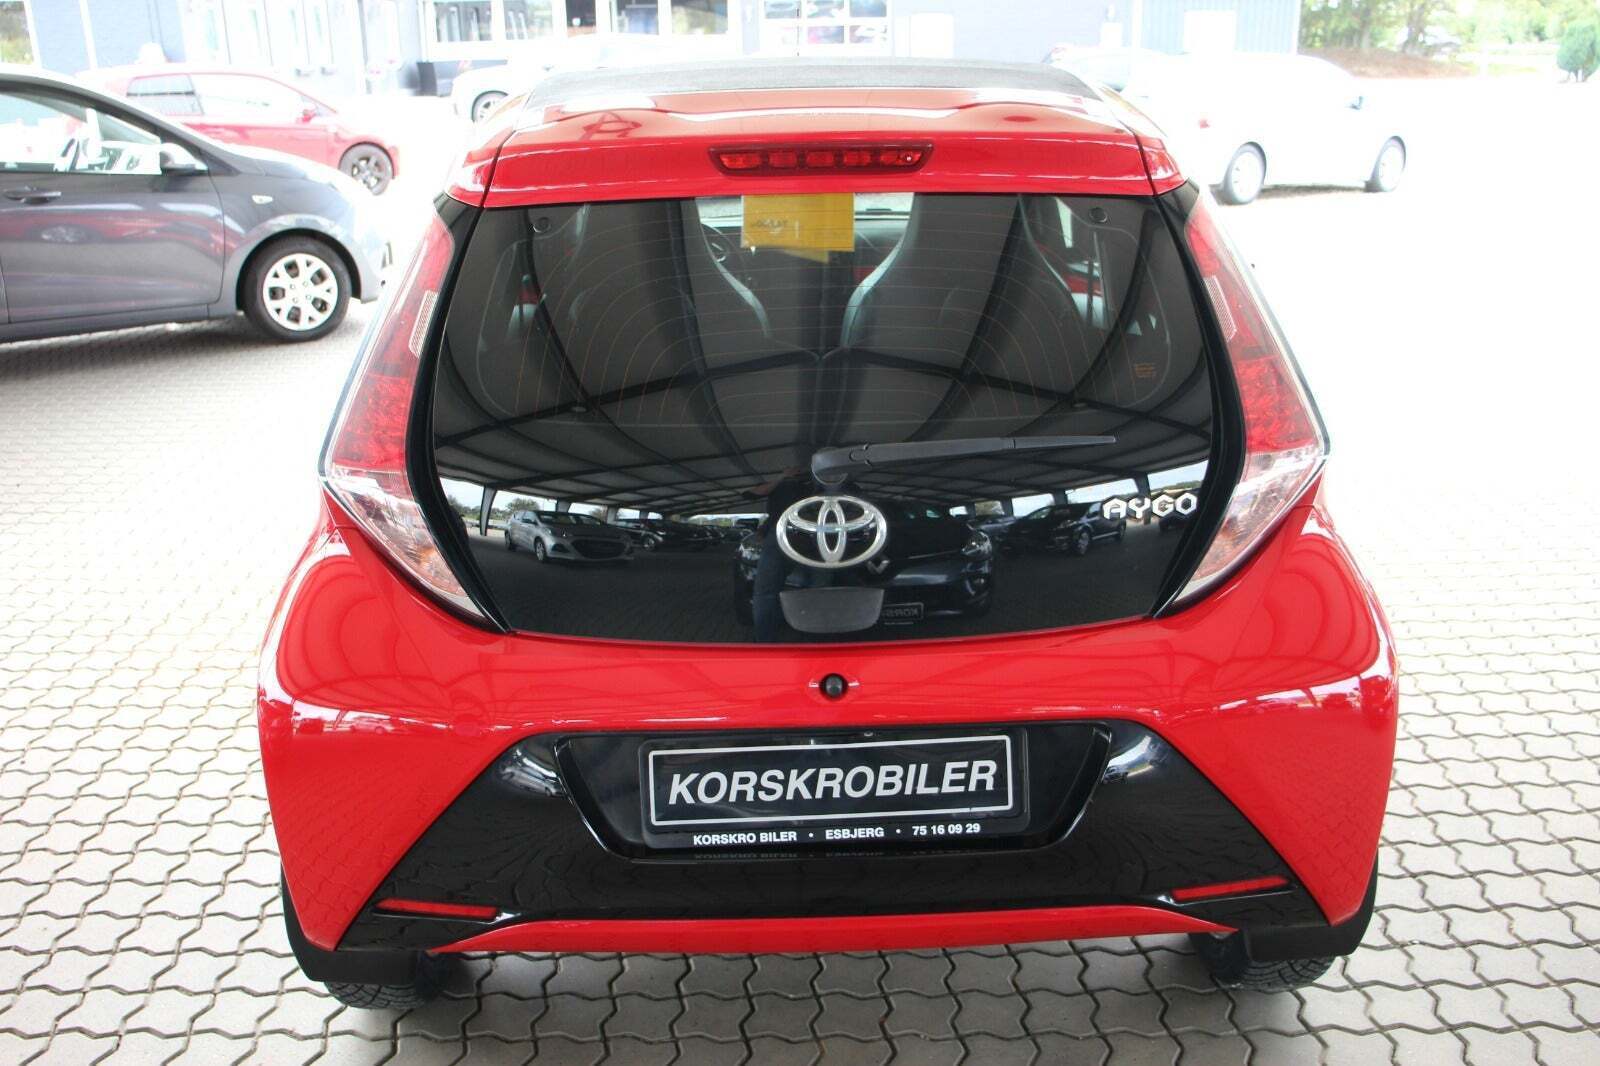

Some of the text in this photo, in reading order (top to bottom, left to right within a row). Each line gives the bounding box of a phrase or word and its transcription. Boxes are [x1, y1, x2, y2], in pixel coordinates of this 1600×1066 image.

[1102, 492, 1198, 519] AYGO
[668, 759, 998, 805] KORSKROBILER
[693, 822, 981, 846] KORSKRO BILER ESBJERG 75 16 09 29
